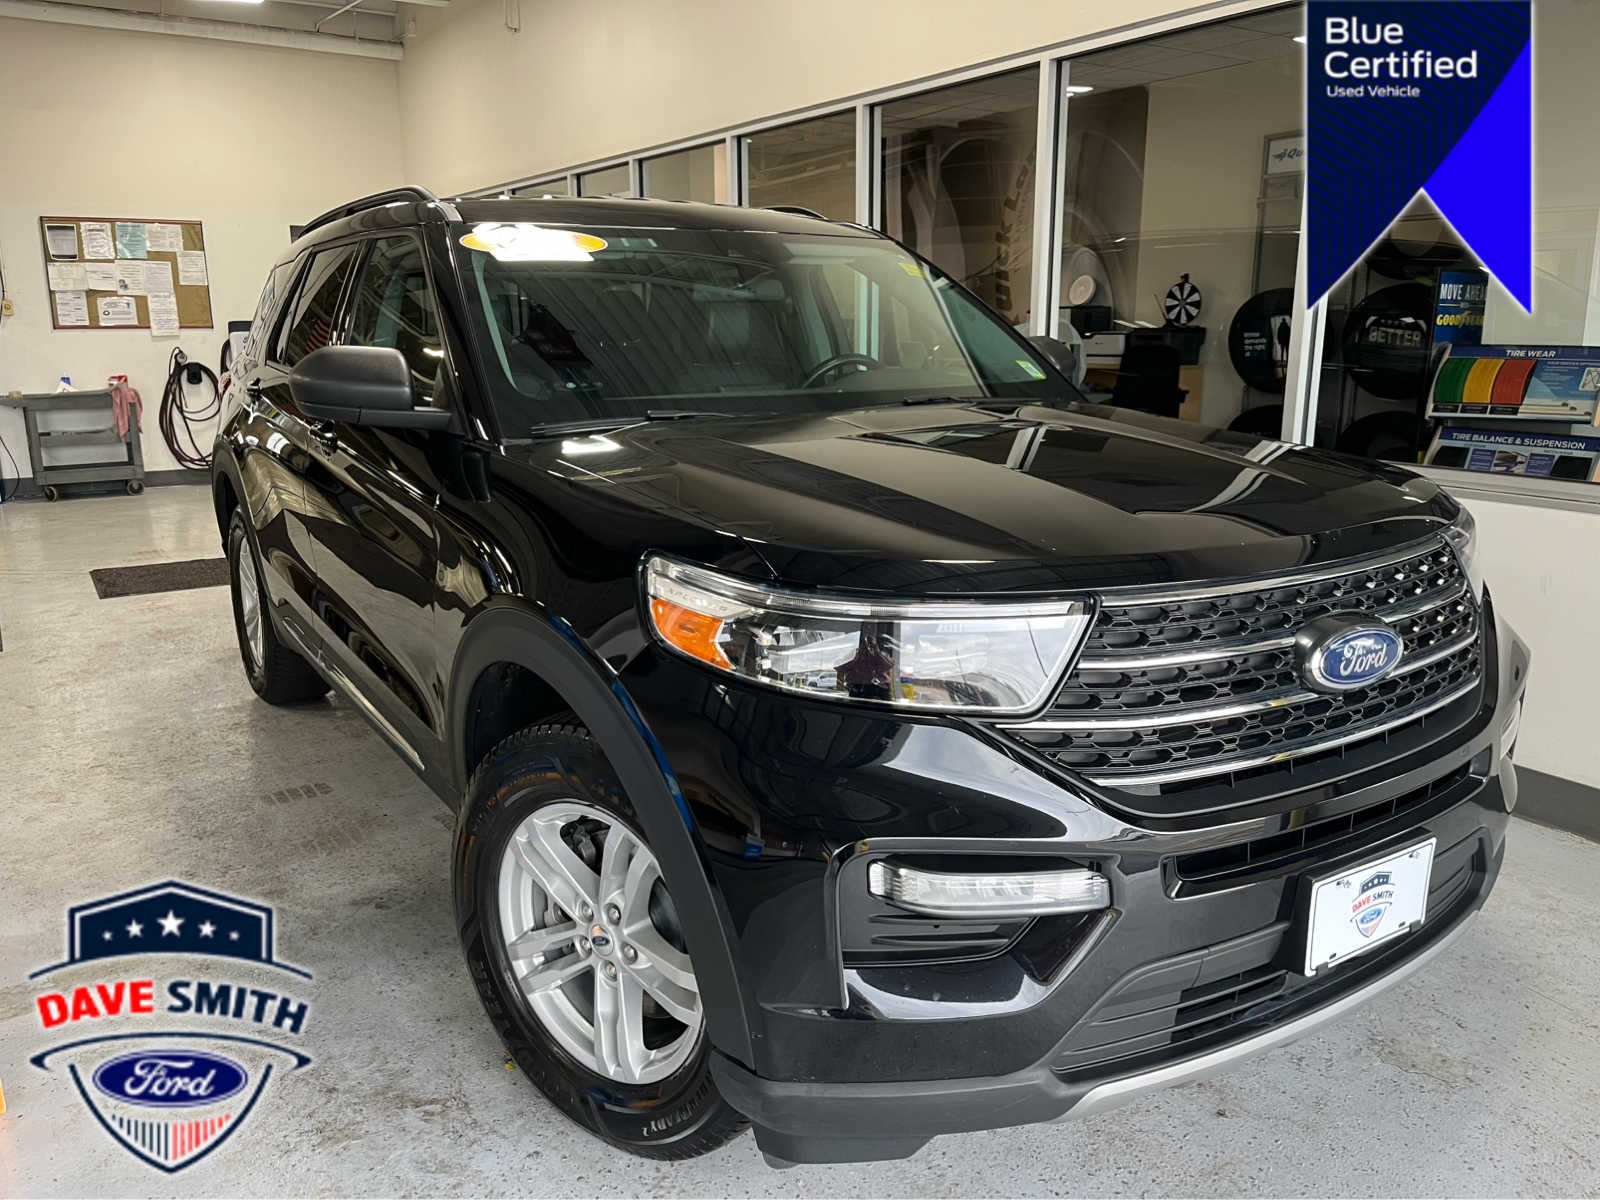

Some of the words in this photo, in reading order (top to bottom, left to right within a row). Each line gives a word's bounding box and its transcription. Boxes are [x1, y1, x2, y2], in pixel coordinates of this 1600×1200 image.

[1440, 283, 1464, 300] MOVE
[1368, 325, 1422, 347] BETTER
[1505, 350, 1528, 358] TIRE
[1528, 350, 1556, 358] WEAR
[1451, 432, 1472, 441] TIRE
[1472, 434, 1514, 445] BALANCE
[1514, 437, 1522, 445] &
[1523, 438, 1586, 450] SUSPENSION
[1340, 638, 1388, 676] Ford
[1352, 895, 1371, 913] DAVE
[1372, 890, 1394, 902] SMITH
